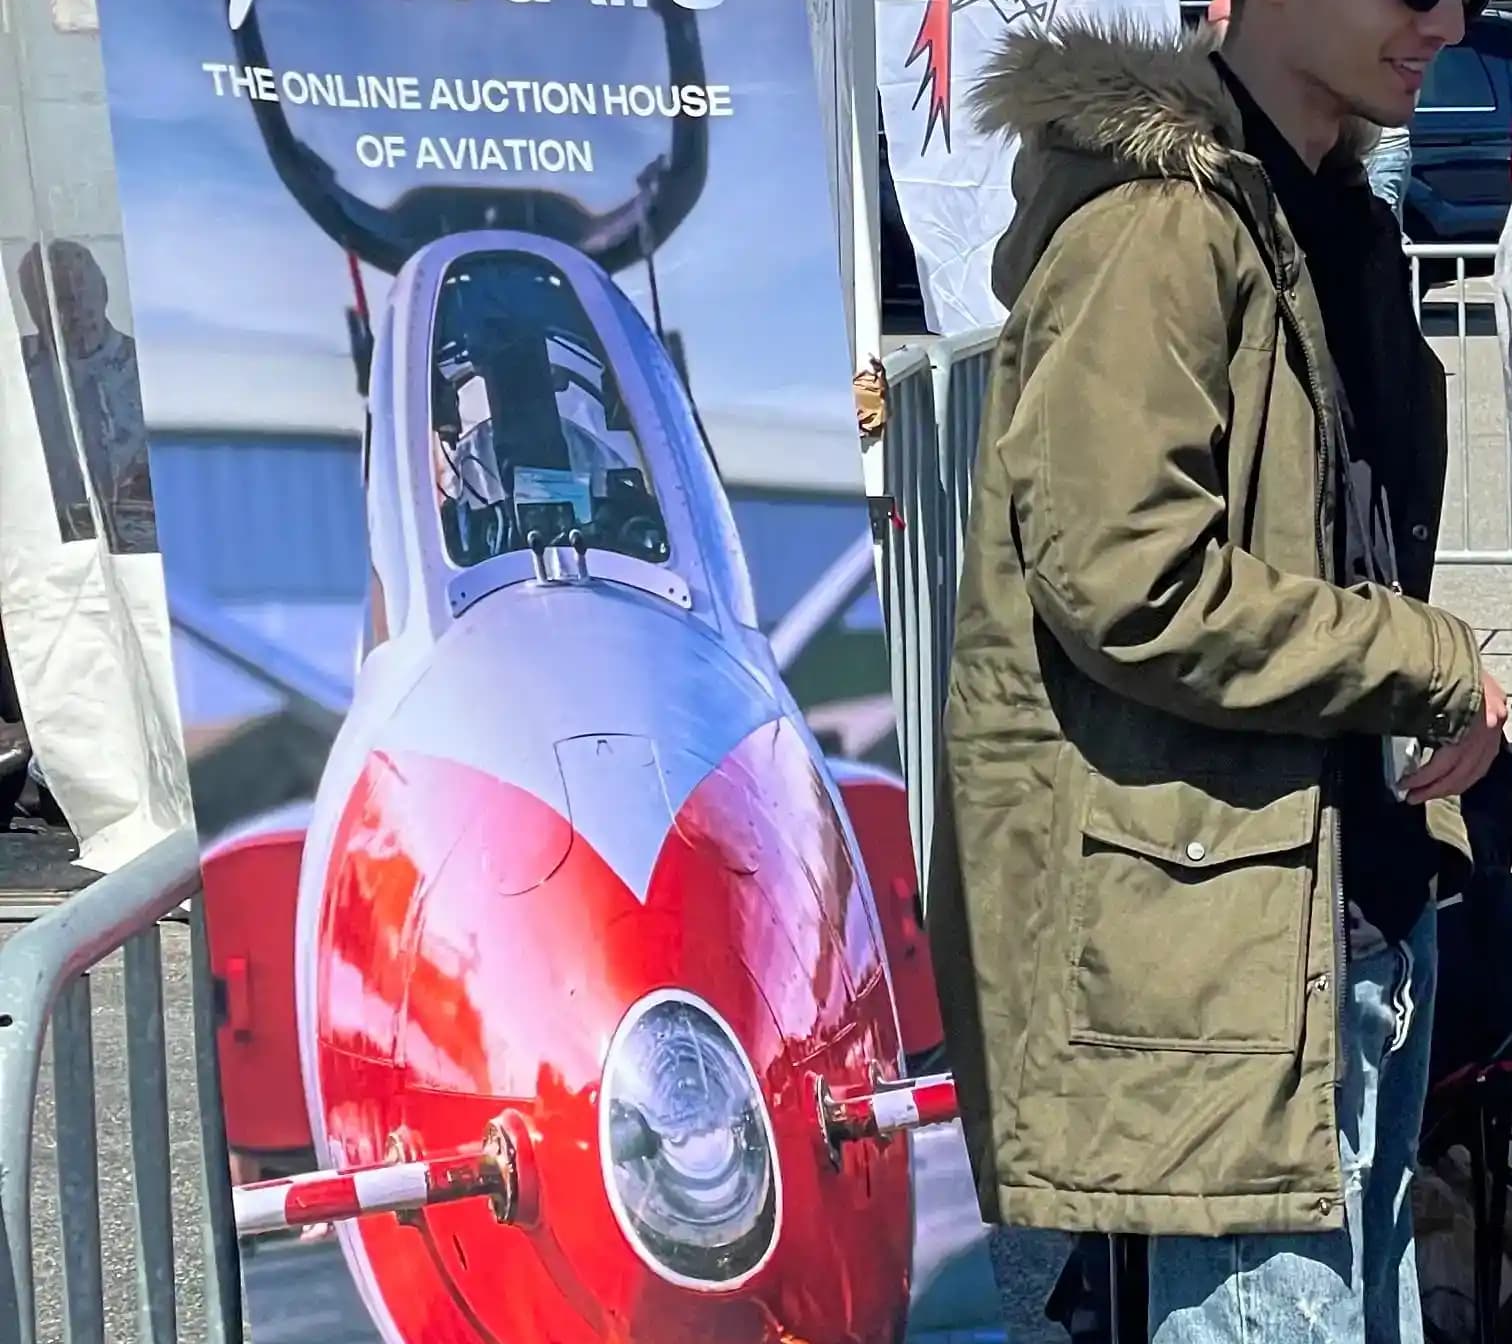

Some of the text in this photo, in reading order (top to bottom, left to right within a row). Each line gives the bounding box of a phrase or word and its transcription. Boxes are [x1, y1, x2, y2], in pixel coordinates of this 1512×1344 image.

[201, 62, 734, 118] THE ONLINE AUCTION HOUSE
[355, 134, 594, 173] OF AVIATION
